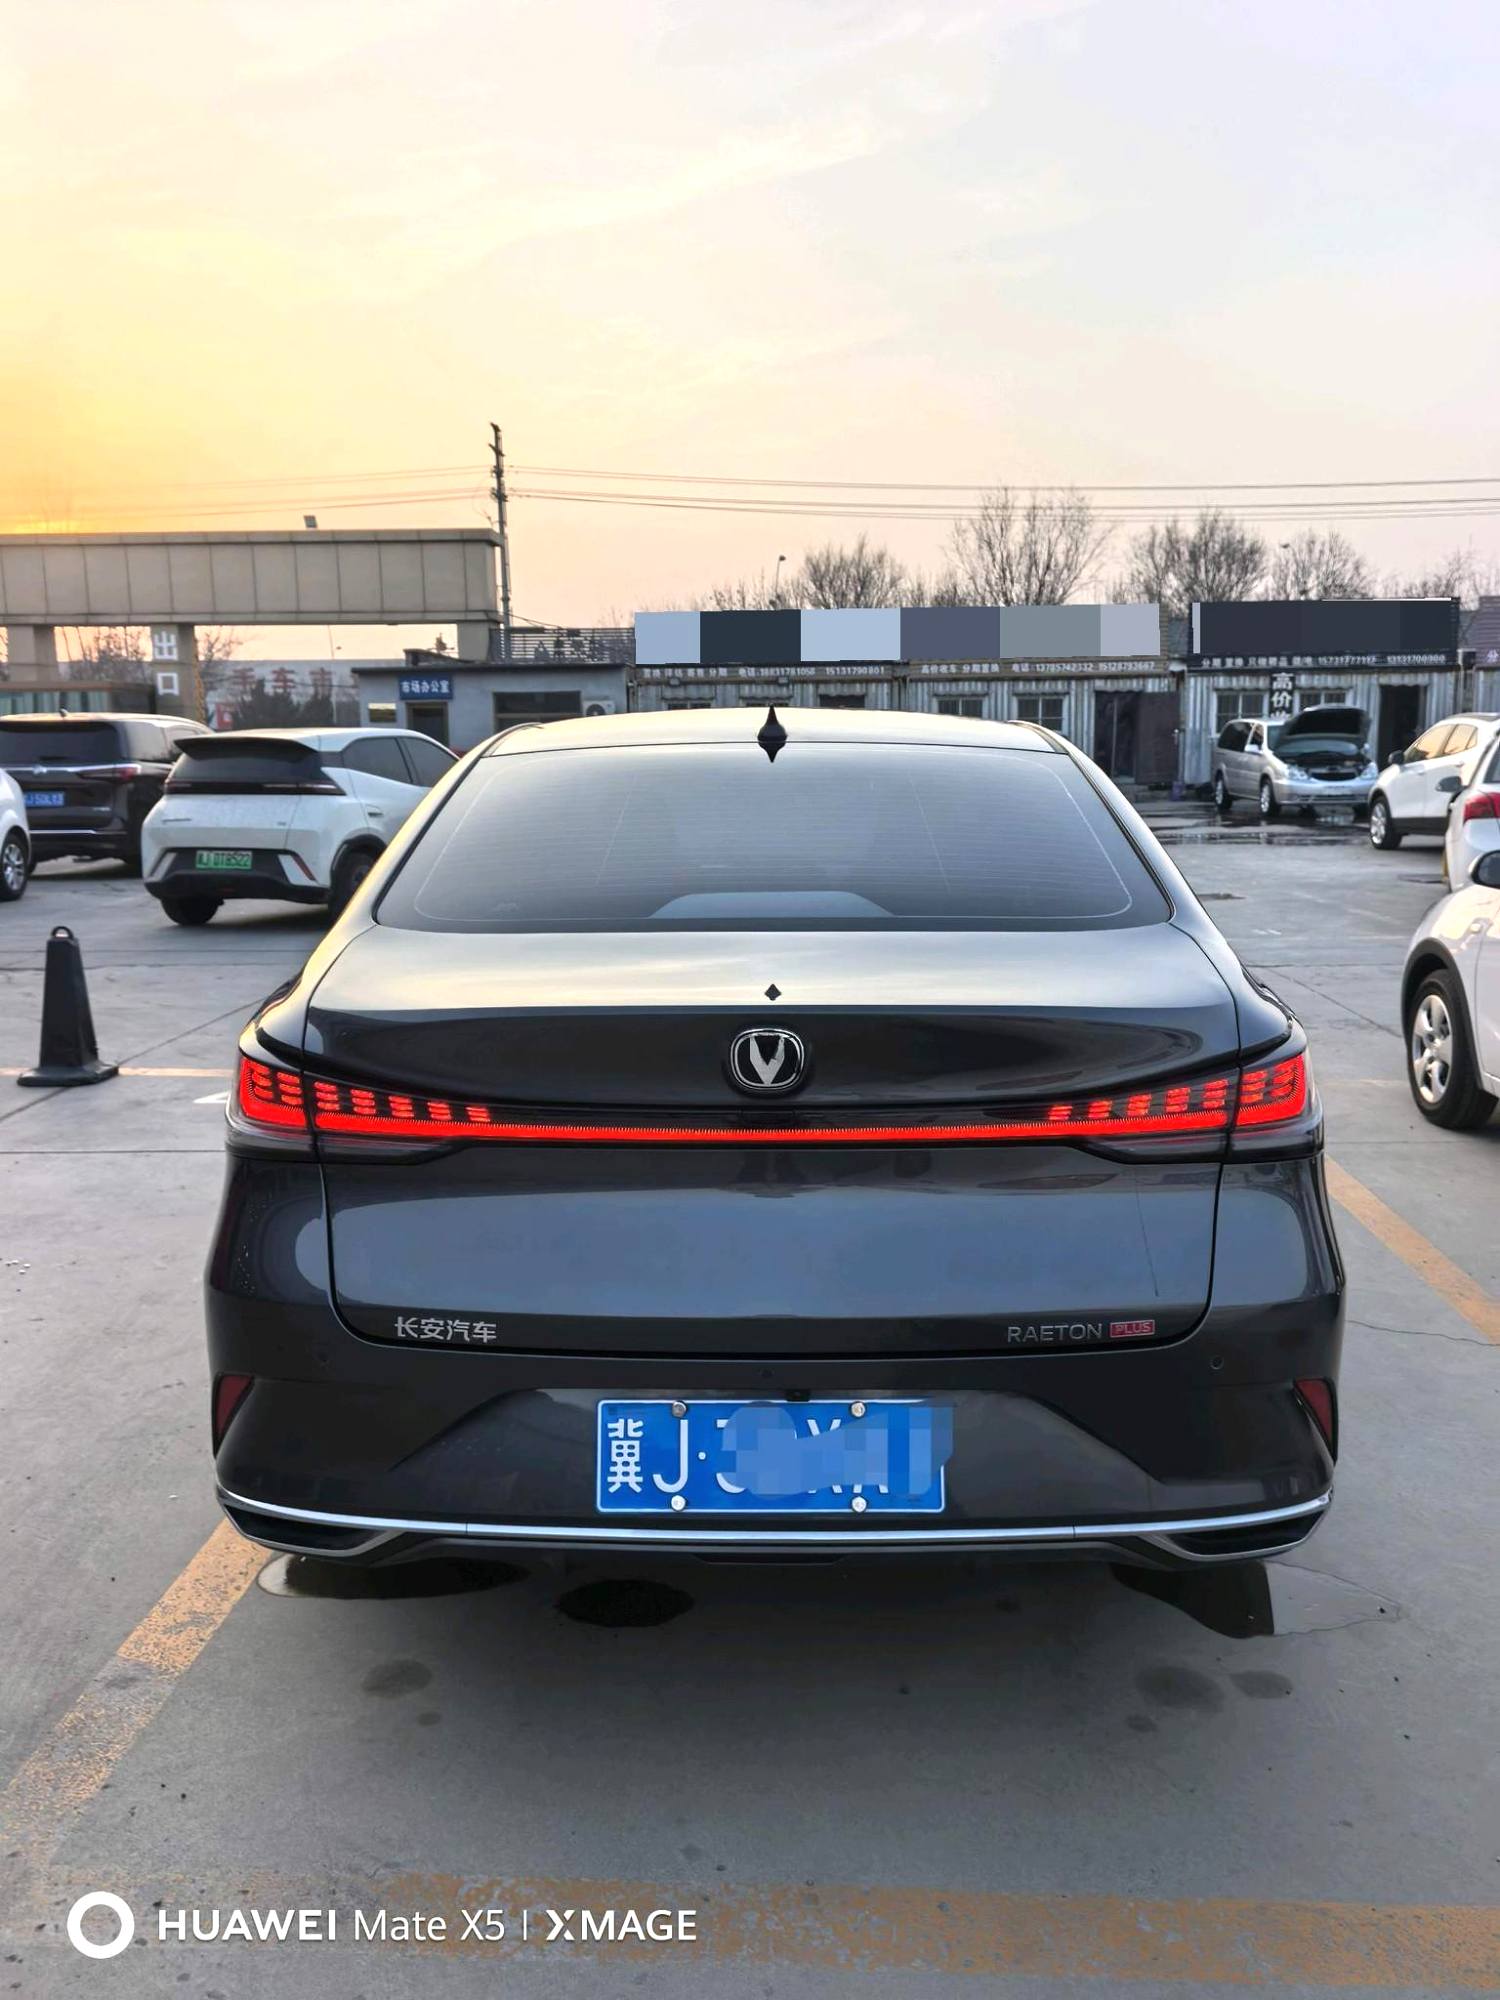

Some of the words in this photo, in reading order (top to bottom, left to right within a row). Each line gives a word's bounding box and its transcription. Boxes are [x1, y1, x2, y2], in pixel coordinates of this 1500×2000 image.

[154, 631, 179, 695] 出口
[400, 680, 449, 693] 市场办公室
[394, 1316, 497, 1343] 长安汽车
[1007, 1323, 1103, 1343] RAETON
[1113, 1322, 1152, 1336] PLUS
